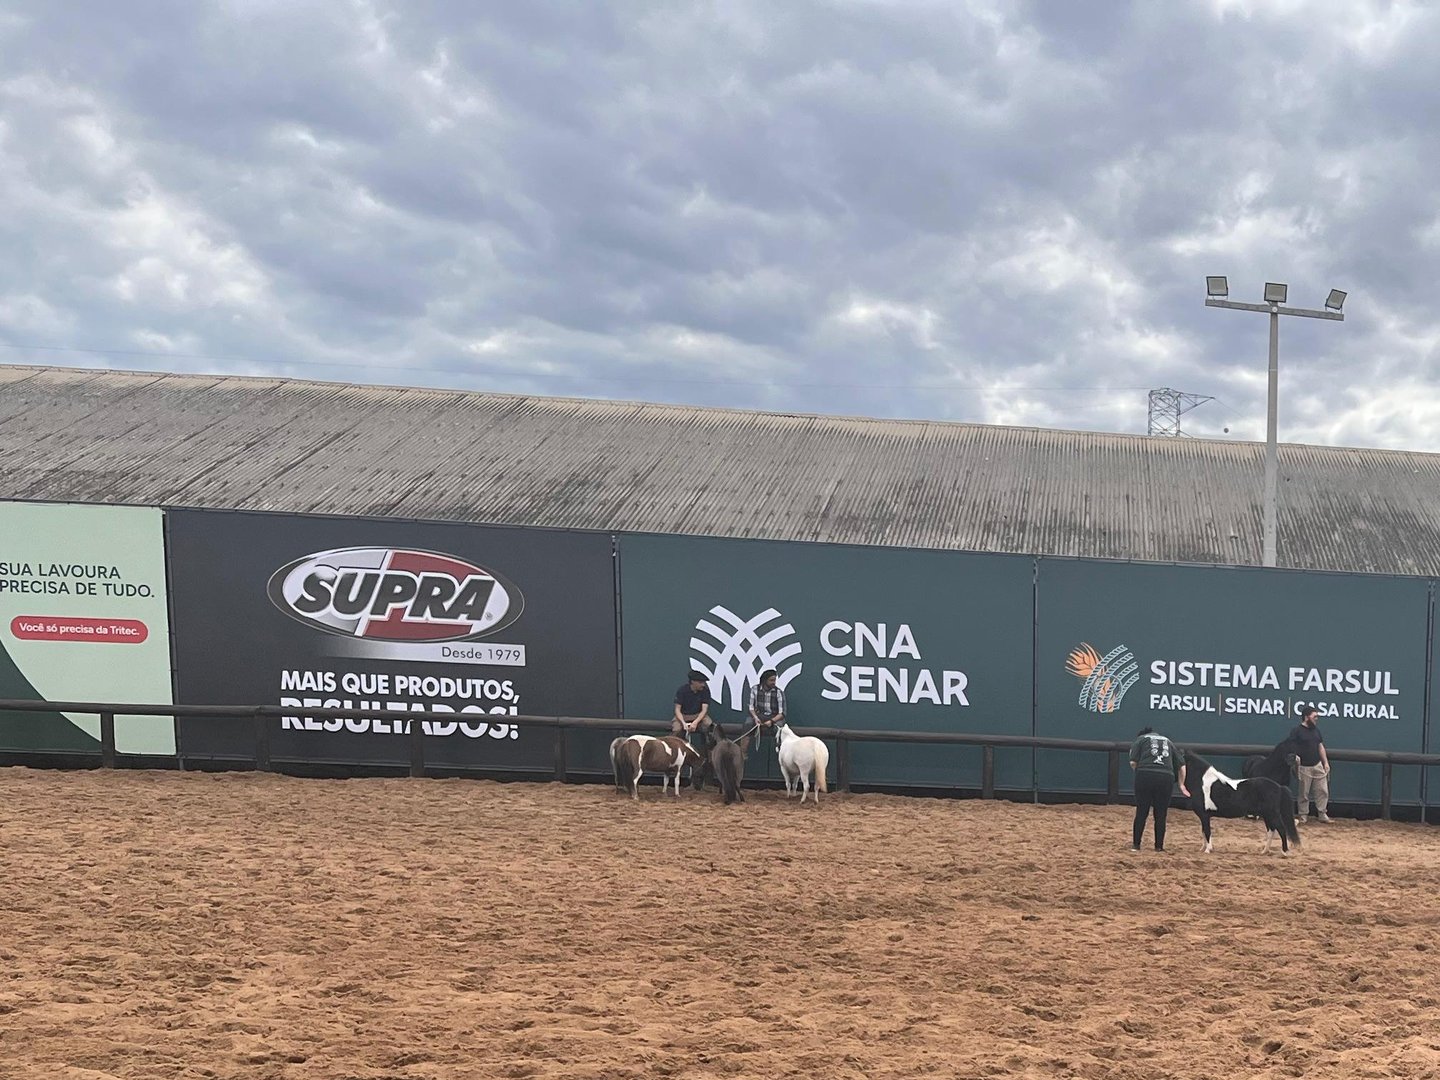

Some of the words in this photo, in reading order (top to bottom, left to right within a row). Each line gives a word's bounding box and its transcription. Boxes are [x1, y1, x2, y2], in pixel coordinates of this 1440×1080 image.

[0, 562, 33, 577] SUA
[38, 563, 121, 580] LAVOURA
[0, 580, 70, 595] PRECISA
[75, 582, 98, 596] DE
[102, 583, 155, 598] TUDO.
[292, 570, 496, 621] SUPRA
[19, 622, 44, 633] Você
[46, 624, 58, 633] só
[59, 624, 94, 636] precisa
[96, 625, 108, 635] da
[109, 625, 140, 637] Tritec.
[819, 620, 922, 660] CNA
[441, 646, 482, 660] Desde
[487, 648, 522, 662] 1979
[281, 670, 337, 692] MAIS
[341, 673, 390, 696] QUE
[395, 677, 520, 704] PRODUTOS,
[820, 664, 970, 706] SENAR
[1150, 660, 1280, 690] SISTEMA
[1288, 667, 1400, 695] FARSUL
[280, 697, 519, 740] RESULTADOS!
[1150, 694, 1216, 712] FARSUL
[1224, 698, 1285, 715] SENAR
[1343, 704, 1400, 720] RURAL
